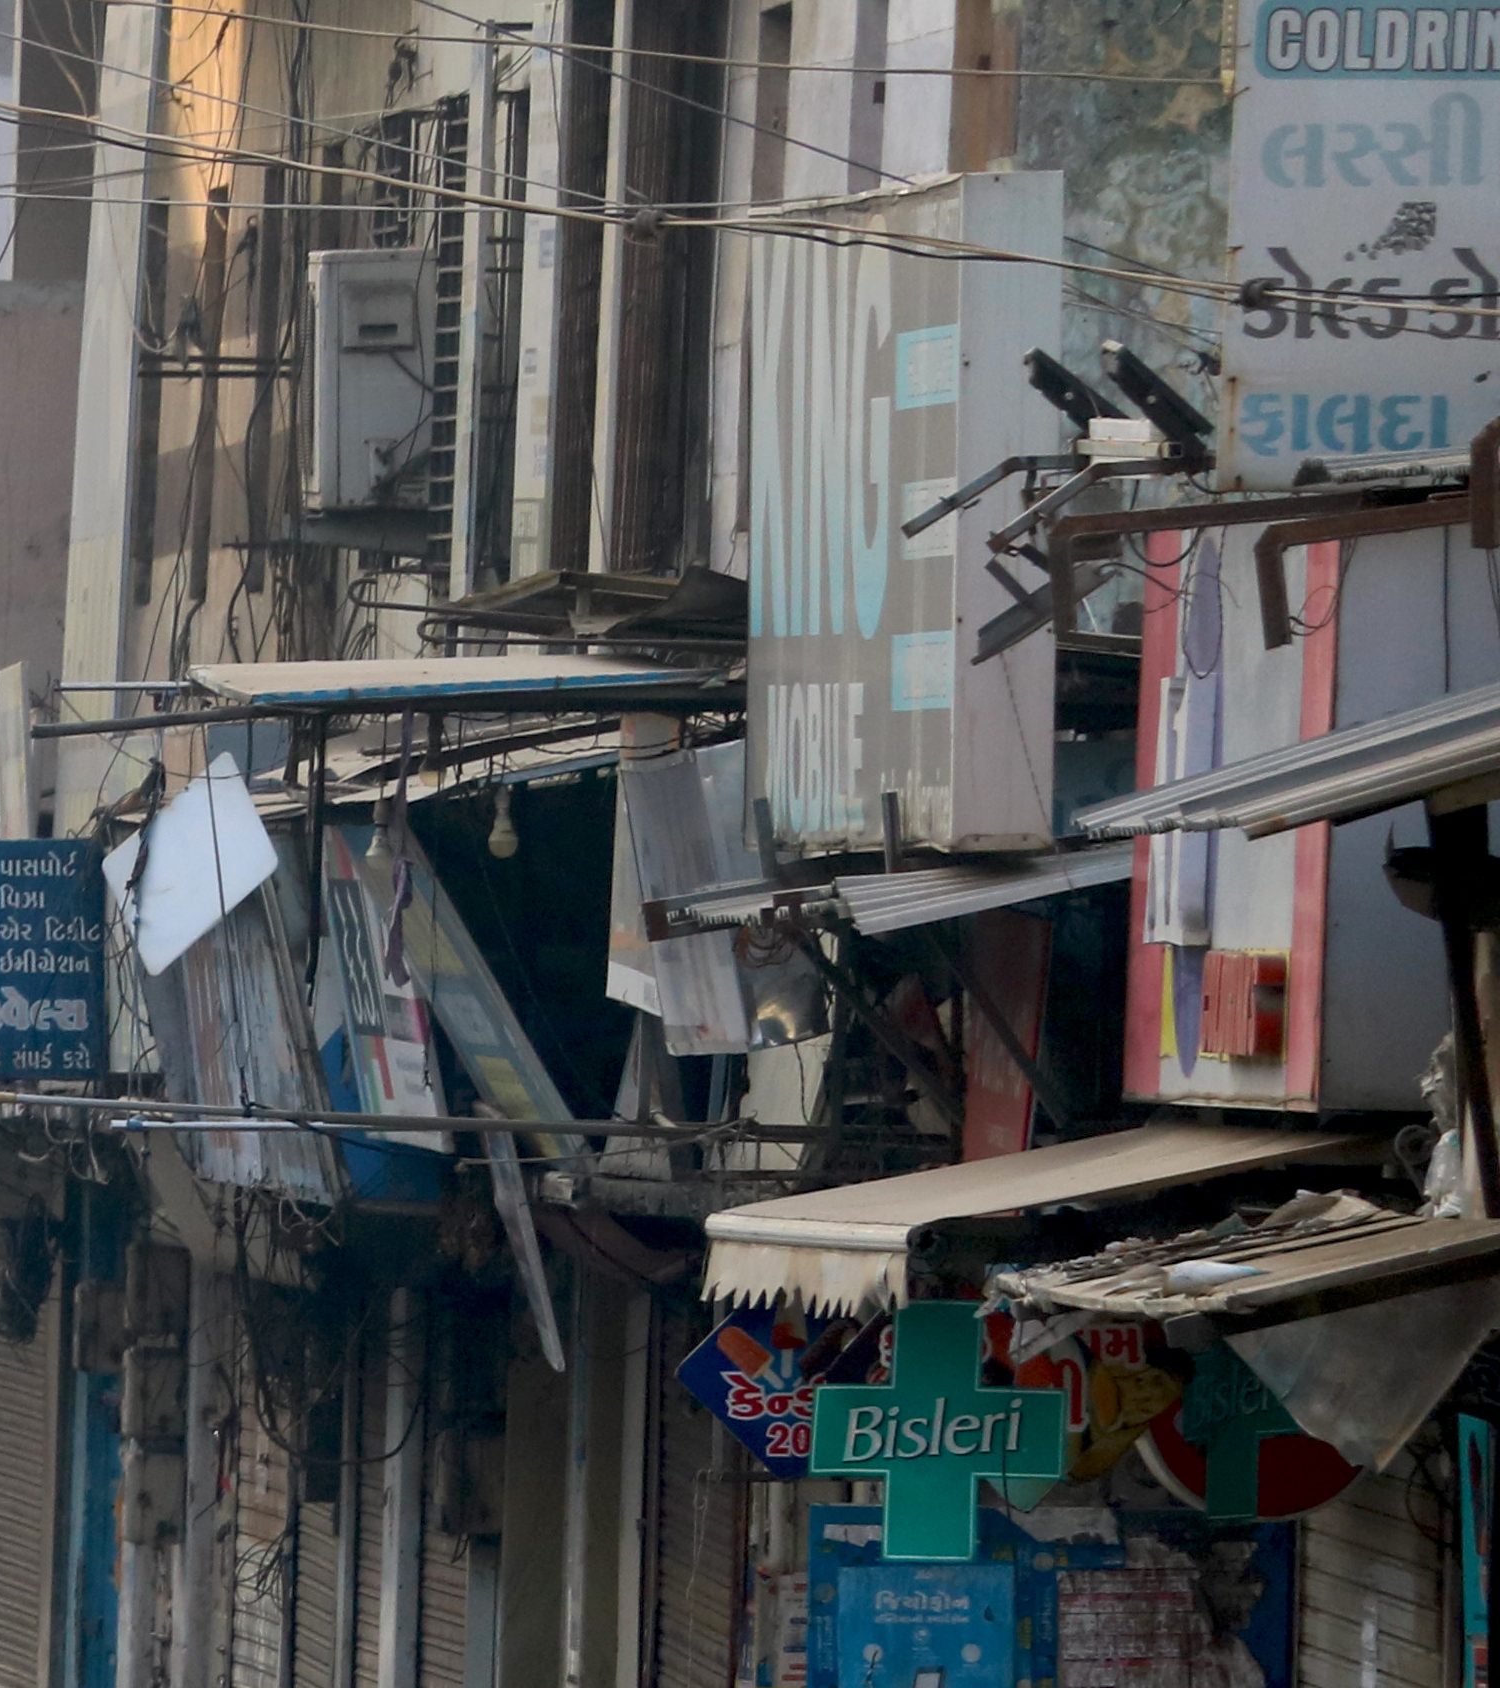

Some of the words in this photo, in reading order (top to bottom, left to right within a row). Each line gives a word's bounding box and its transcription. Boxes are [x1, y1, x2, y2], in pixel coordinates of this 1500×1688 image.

[750, 214, 891, 639] KING
[765, 682, 865, 836] MOBILE
[0, 850, 77, 877] પાસપોર્ટ
[0, 916, 33, 941] એર
[843, 1397, 1023, 1463] Bisleri
